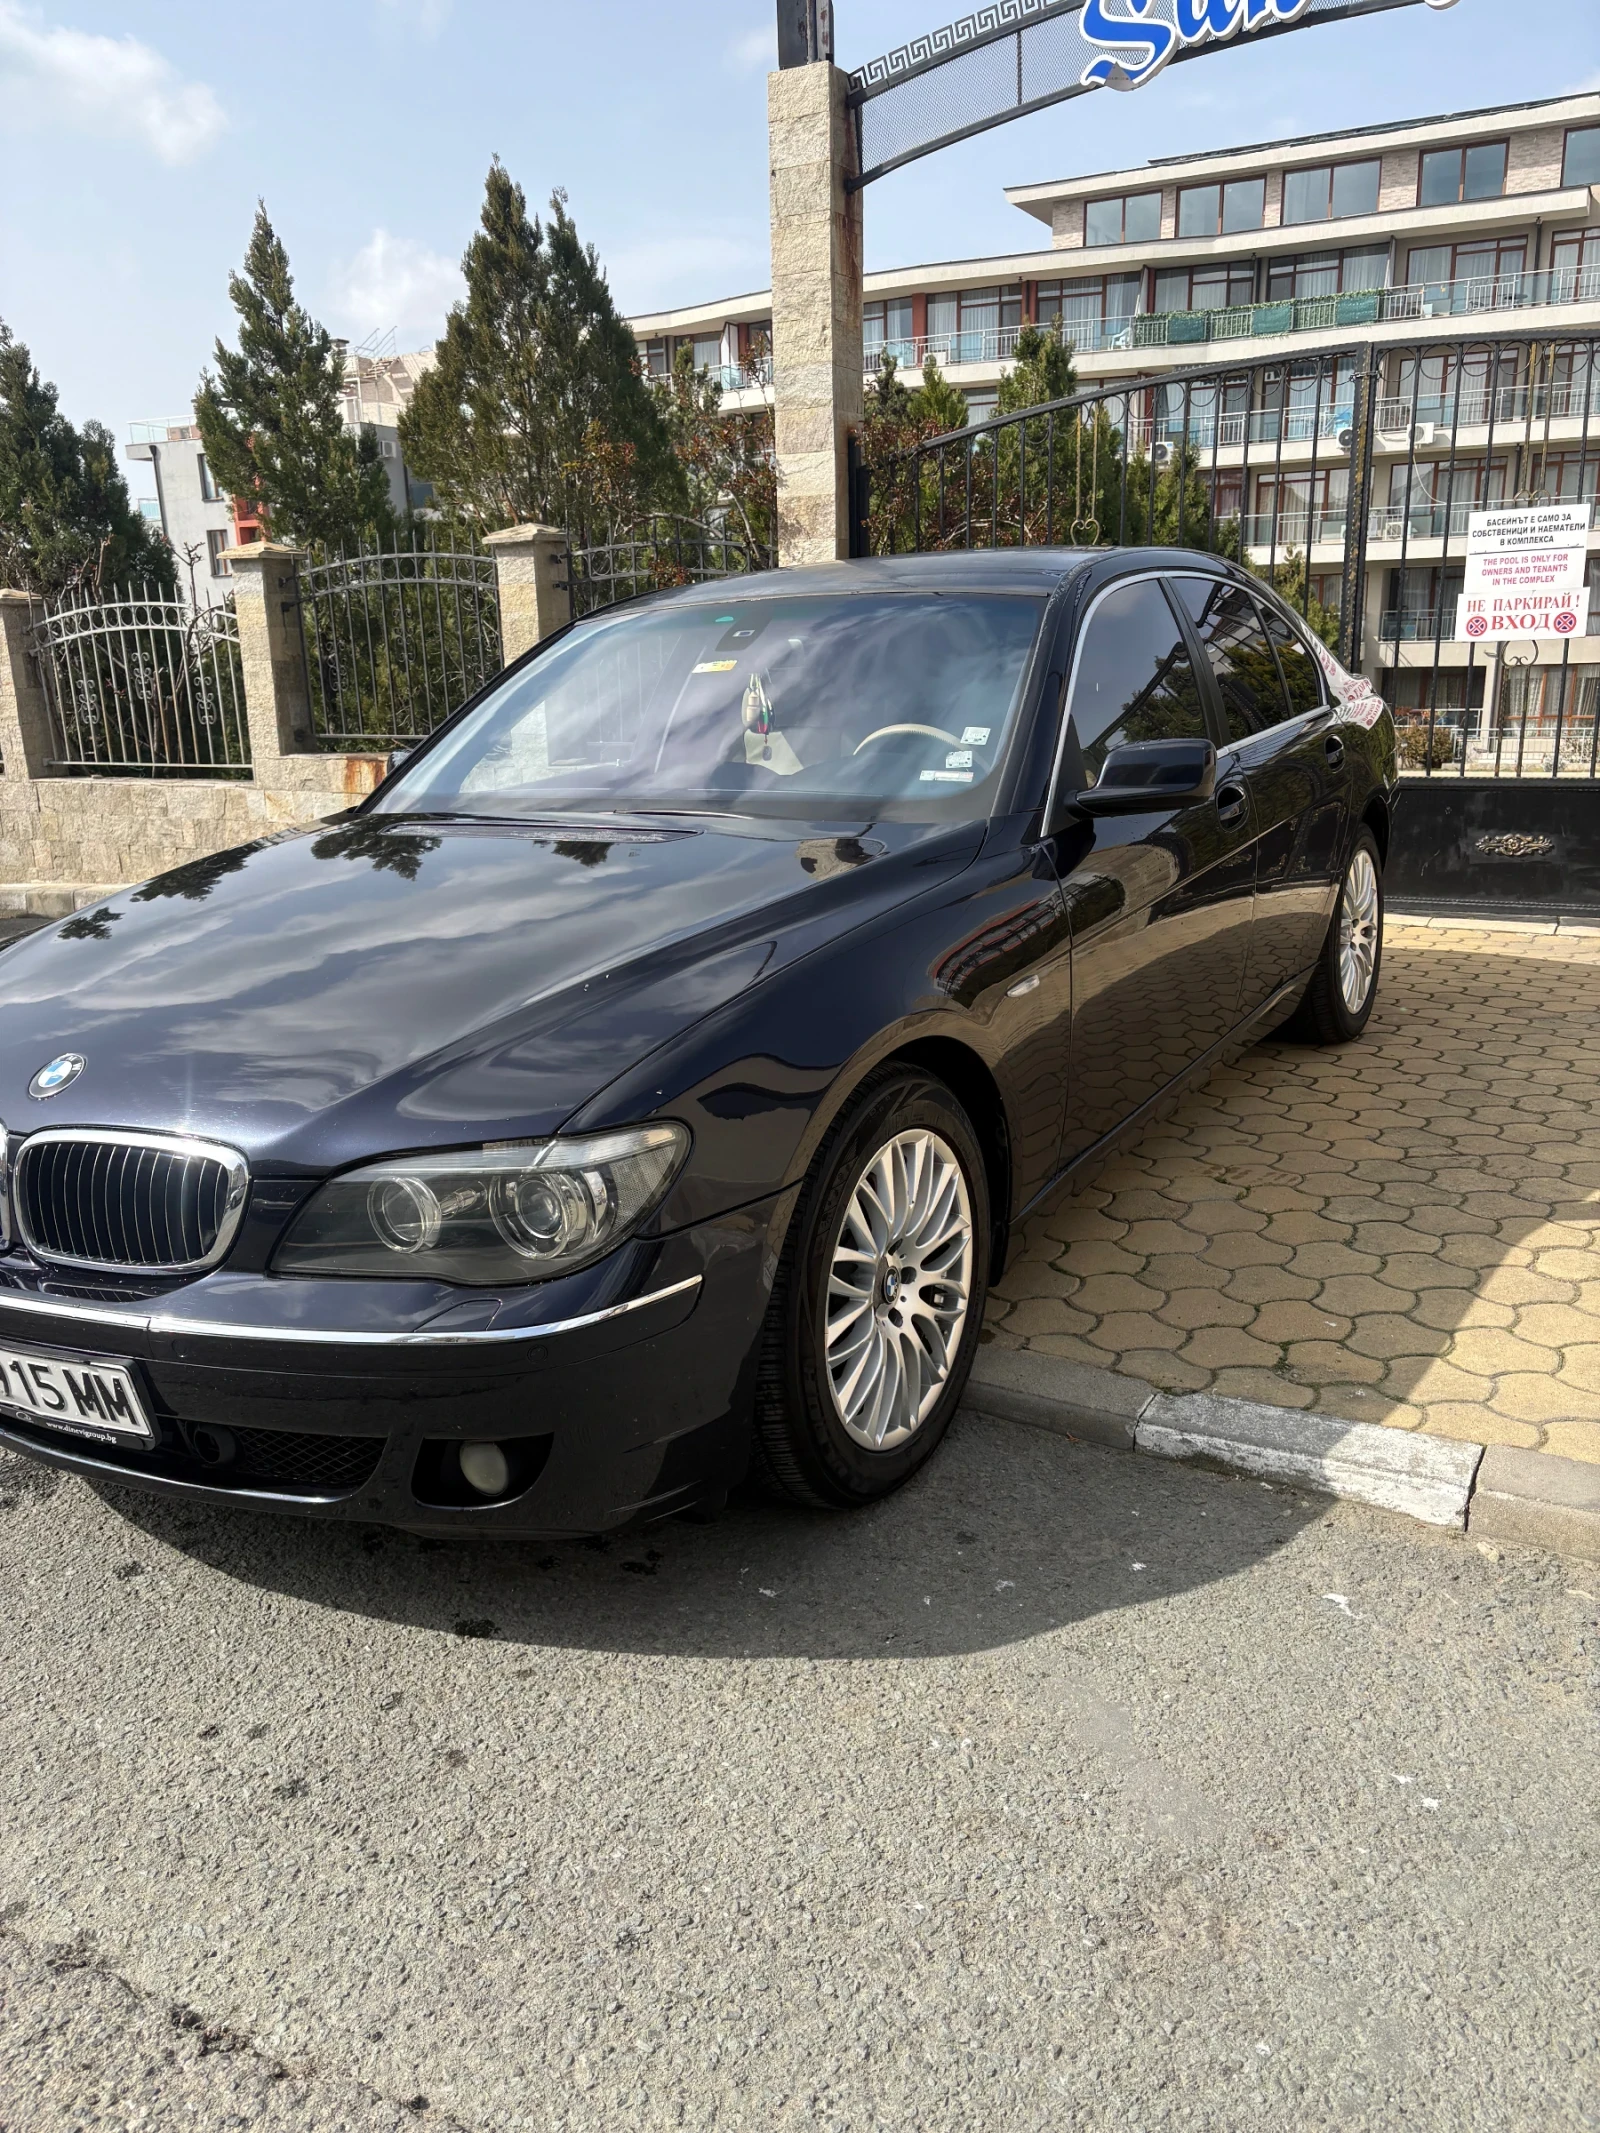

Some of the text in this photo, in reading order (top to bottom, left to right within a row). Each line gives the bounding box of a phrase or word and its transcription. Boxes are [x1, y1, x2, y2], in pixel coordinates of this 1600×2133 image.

[1486, 513, 1572, 527] БАСЕЙНЪТ Е САМО ЗА
[1472, 522, 1586, 538] СОБСТВЕНИЦИ И НАЕМАТЕЛИ
[1500, 535, 1554, 546] В КОМПЛЕКСА
[1483, 553, 1569, 566] THE POOL IS ONLY FOR
[1481, 563, 1568, 576] OWNERS AND TENANTS
[1492, 575, 1555, 586] IN THE COMPLEX
[1467, 599, 1486, 613] НЕ
[1490, 613, 1550, 632] ВХОД
